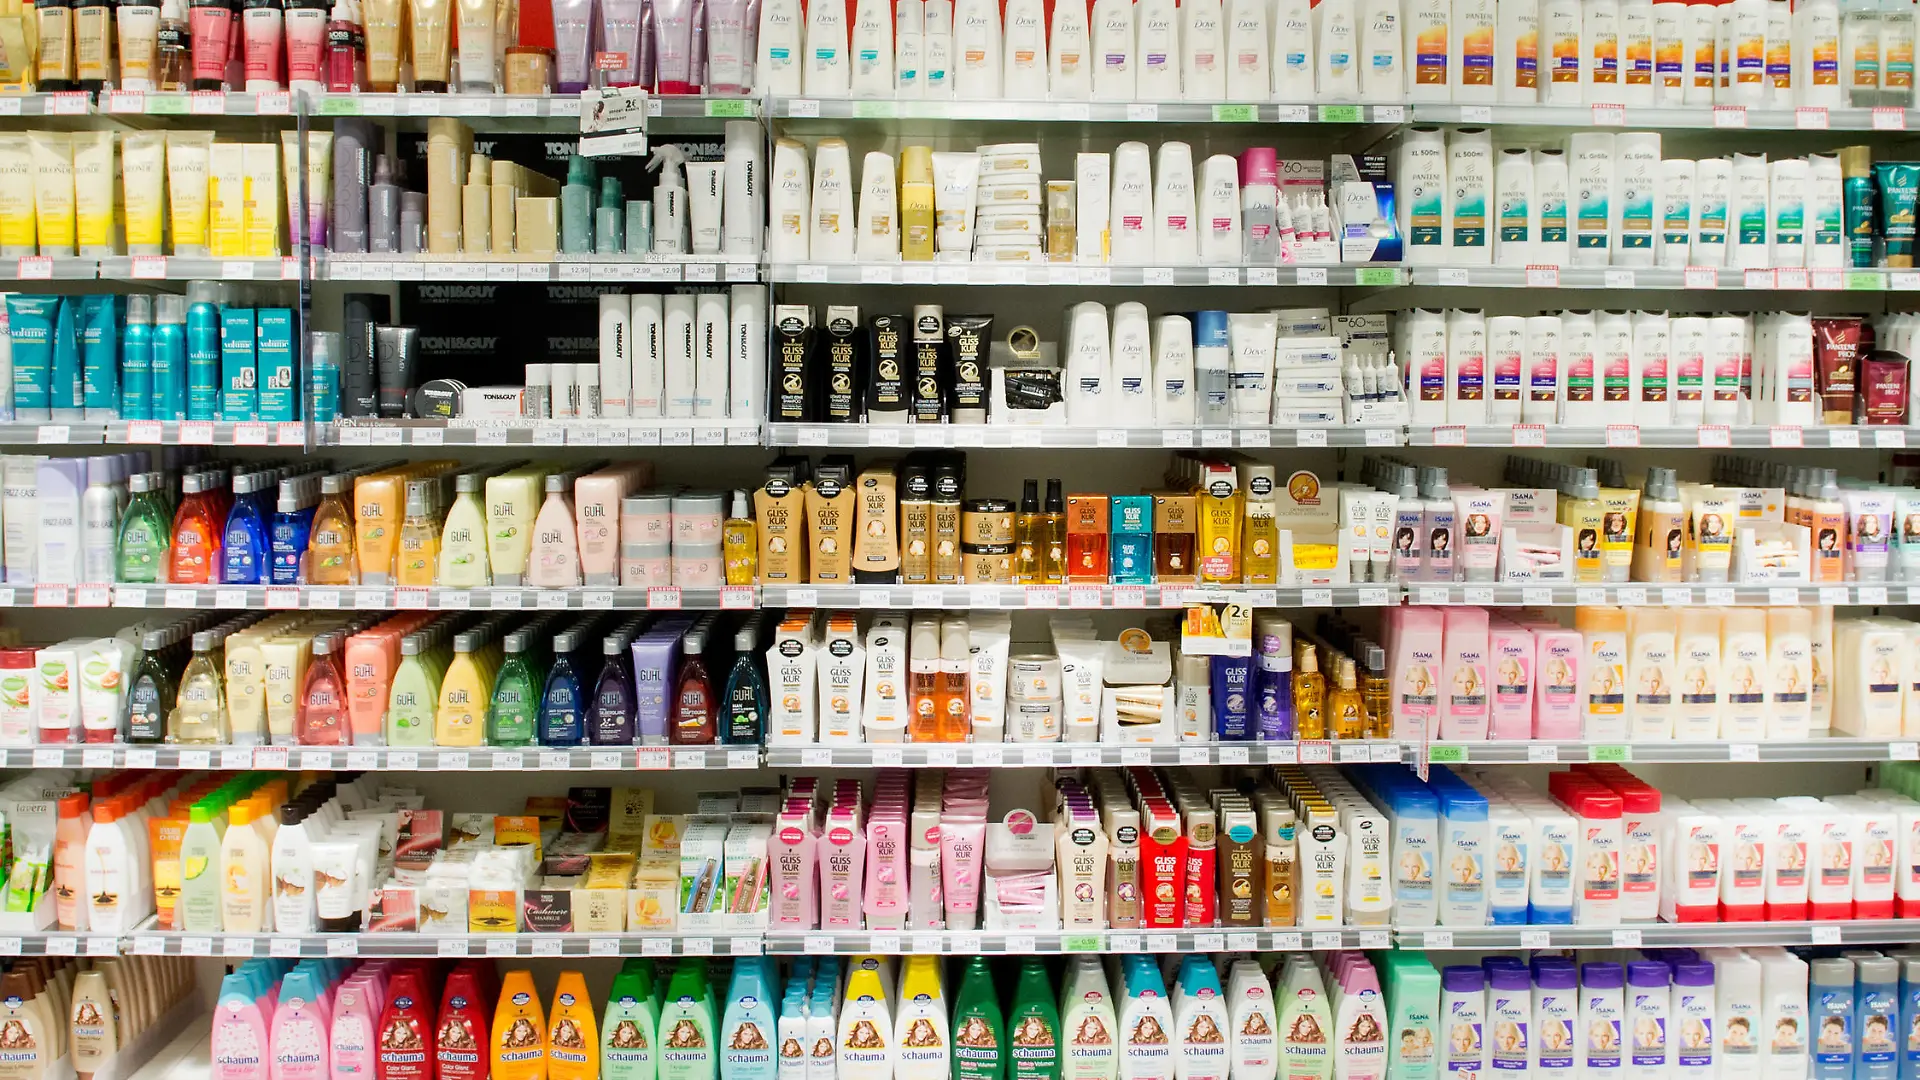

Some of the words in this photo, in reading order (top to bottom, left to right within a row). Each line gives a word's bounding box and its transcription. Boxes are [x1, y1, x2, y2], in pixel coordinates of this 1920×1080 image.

[770, 14, 792, 22] Dove
[966, 16, 987, 25] Dove
[861, 20, 881, 30] Dove
[1060, 23, 1082, 32] Dove
[1106, 20, 1128, 29] Dove
[1194, 20, 1216, 29] Dove
[1237, 20, 1259, 29] Dove
[1373, 22, 1394, 31] Dove
[1330, 25, 1350, 34] Dove
[1285, 162, 1302, 173] 60
[819, 179, 841, 189] Dove
[1122, 183, 1144, 192] Dove
[1213, 187, 1234, 197] Dove
[909, 202, 930, 210] Dove
[1252, 202, 1274, 211] Dove
[418, 285, 496, 298] TONI&GUY
[11, 328, 47, 337] volume
[260, 339, 288, 348] volume
[419, 337, 497, 350] TONI&GUY
[878, 335, 898, 343] GLISS
[958, 338, 979, 346] GLISS
[224, 340, 251, 349] volume
[880, 342, 896, 350] KUR
[961, 345, 977, 353] KUR
[1080, 344, 1102, 354] Dove
[1122, 344, 1144, 353] Dove
[781, 347, 805, 355] GLISS
[1243, 347, 1268, 357] Dove
[784, 354, 802, 363] KUR
[917, 352, 938, 360] GLISS
[919, 359, 936, 367] KUR
[334, 419, 357, 427] MEN
[866, 494, 886, 503] GLISS
[766, 509, 789, 518] GLISS
[1210, 510, 1232, 518] GLISS
[768, 517, 786, 526] KUR
[1213, 517, 1230, 526] KUR
[647, 522, 664, 531] GUHL
[679, 523, 694, 532] GUHL
[274, 525, 293, 539] GUHL
[450, 531, 472, 542] GUHL
[125, 531, 149, 544] GUHL
[177, 531, 201, 545] GUHL
[317, 533, 340, 545] GUHL
[541, 532, 564, 544] GUHL
[728, 534, 747, 545] GUHL
[404, 540, 422, 550] GUHL
[1231, 605, 1241, 618] 2
[1242, 609, 1249, 618] €
[1412, 652, 1433, 660] ISANA
[230, 663, 253, 675] GUHL
[353, 666, 376, 677] GUHL
[780, 668, 802, 676] GLISS
[830, 668, 852, 676] GLISS
[1225, 667, 1247, 676] GLISS
[640, 669, 662, 681] GUHL
[782, 675, 801, 683] KUR
[1227, 675, 1245, 684] KUR
[832, 676, 850, 684] KUR
[185, 689, 208, 701] GUHL
[310, 694, 332, 705] GUHL
[448, 692, 470, 703] GUHL
[500, 691, 521, 703] GUHL
[550, 691, 571, 703] GUHL
[600, 693, 622, 705] GUHL
[682, 693, 704, 705] GUHL
[732, 689, 755, 701] GUHL
[16, 804, 47, 812] lavera
[876, 841, 896, 849] GLISS
[1405, 837, 1427, 845] ISANA
[878, 848, 894, 856] KUR
[779, 856, 802, 864] GLISS
[1154, 856, 1177, 865] GLISS
[1314, 853, 1336, 862] GLISS
[781, 864, 799, 872] KUR
[1156, 863, 1175, 873] KUR
[1316, 861, 1334, 870] KUR
[527, 904, 567, 915] Cashmere
[1240, 1037, 1272, 1045] schauma
[901, 1050, 943, 1060] schauma
[955, 1048, 998, 1059] schauma
[1012, 1048, 1056, 1058] schauma
[1071, 1048, 1112, 1057] schauma
[1128, 1048, 1169, 1057] schauma
[1183, 1046, 1225, 1056] schauma
[1285, 1045, 1327, 1056] schauma
[1344, 1045, 1385, 1056] schauma
[277, 1054, 320, 1064] schauma
[381, 1052, 425, 1062] schauma
[500, 1050, 543, 1062] schauma
[607, 1052, 648, 1062] schauma
[664, 1052, 707, 1061] schauma
[727, 1054, 770, 1064] schauma
[843, 1052, 886, 1062] schauma
